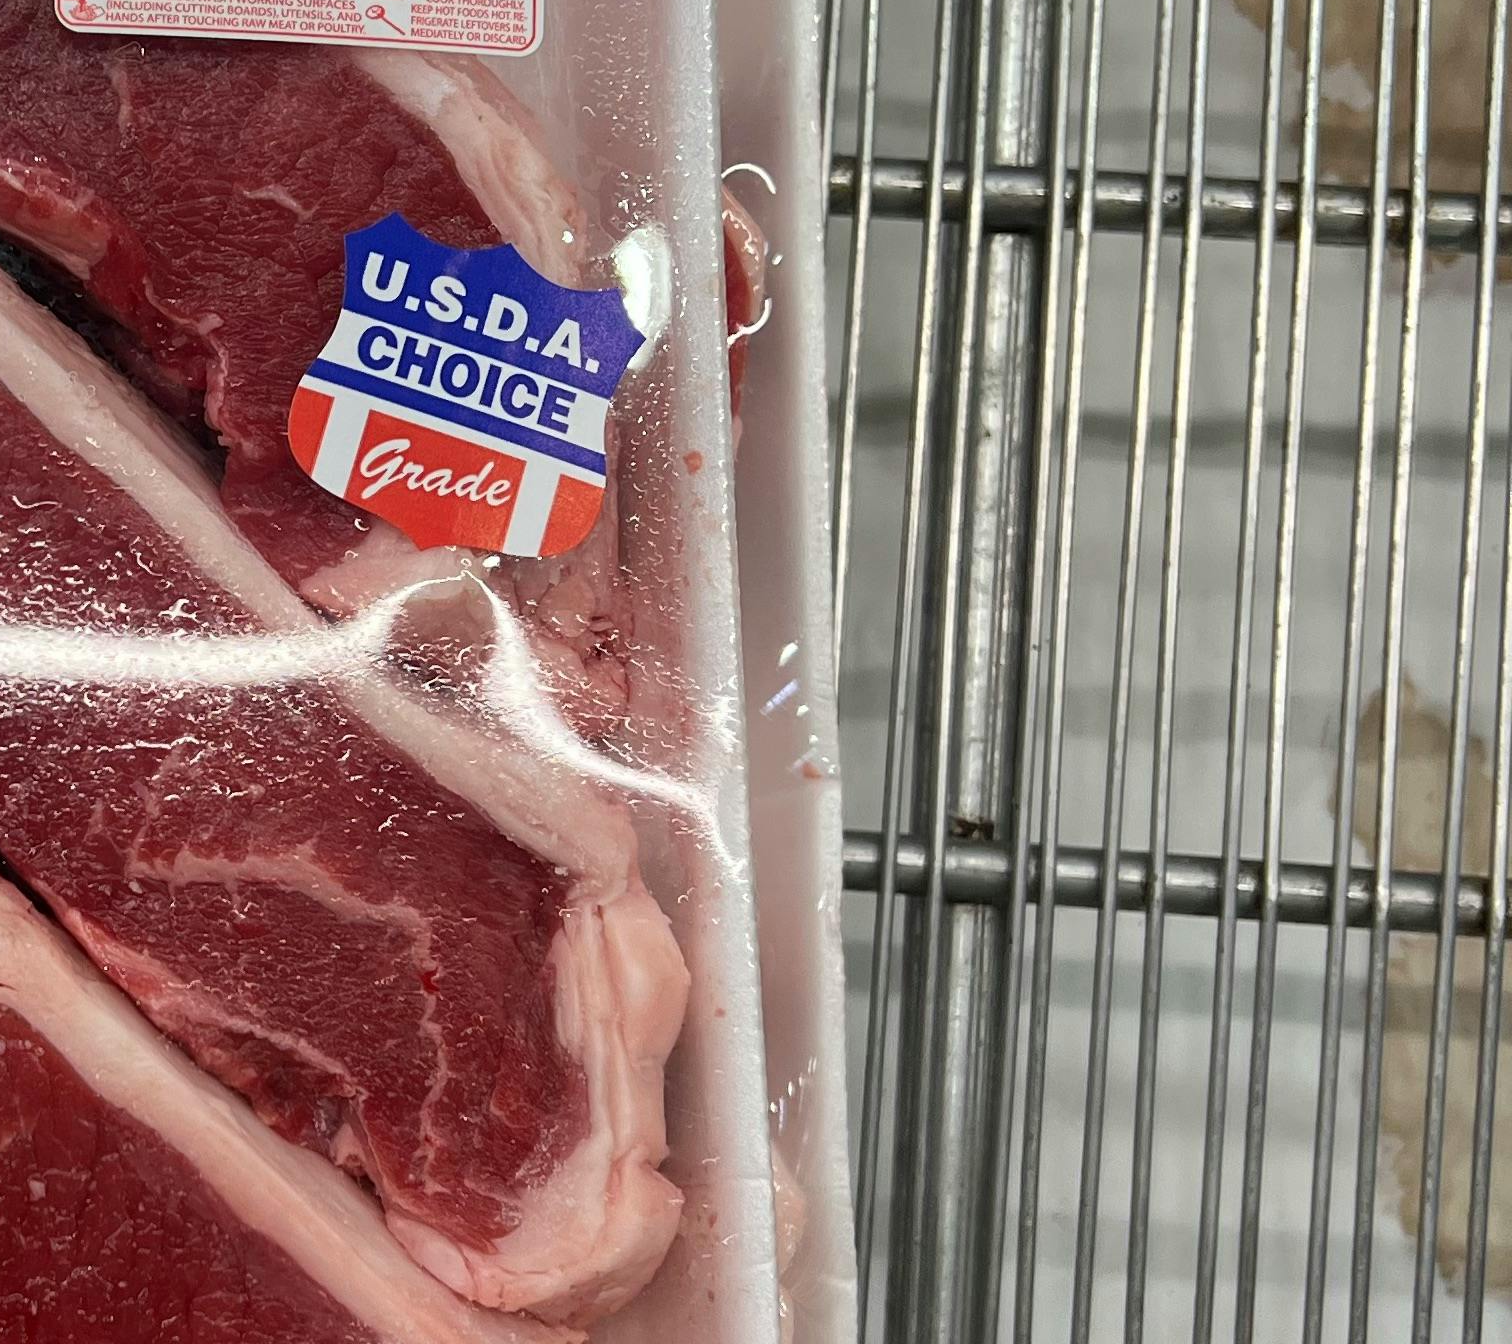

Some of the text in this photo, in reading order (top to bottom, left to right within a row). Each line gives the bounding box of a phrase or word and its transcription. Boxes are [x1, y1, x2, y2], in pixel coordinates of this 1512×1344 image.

[105, 12, 144, 23] HANDS
[147, 13, 180, 24] AFTER
[182, 15, 239, 27] TOUCHING
[241, 18, 267, 28] RAW
[270, 19, 297, 31] MEAT
[300, 21, 315, 32] OR
[174, 3, 225, 15] CUTTING
[337, 11, 362, 23] AND
[360, 250, 601, 375] U.S.D.A.
[355, 324, 578, 436] CHOICE
[359, 437, 515, 508] Grade
